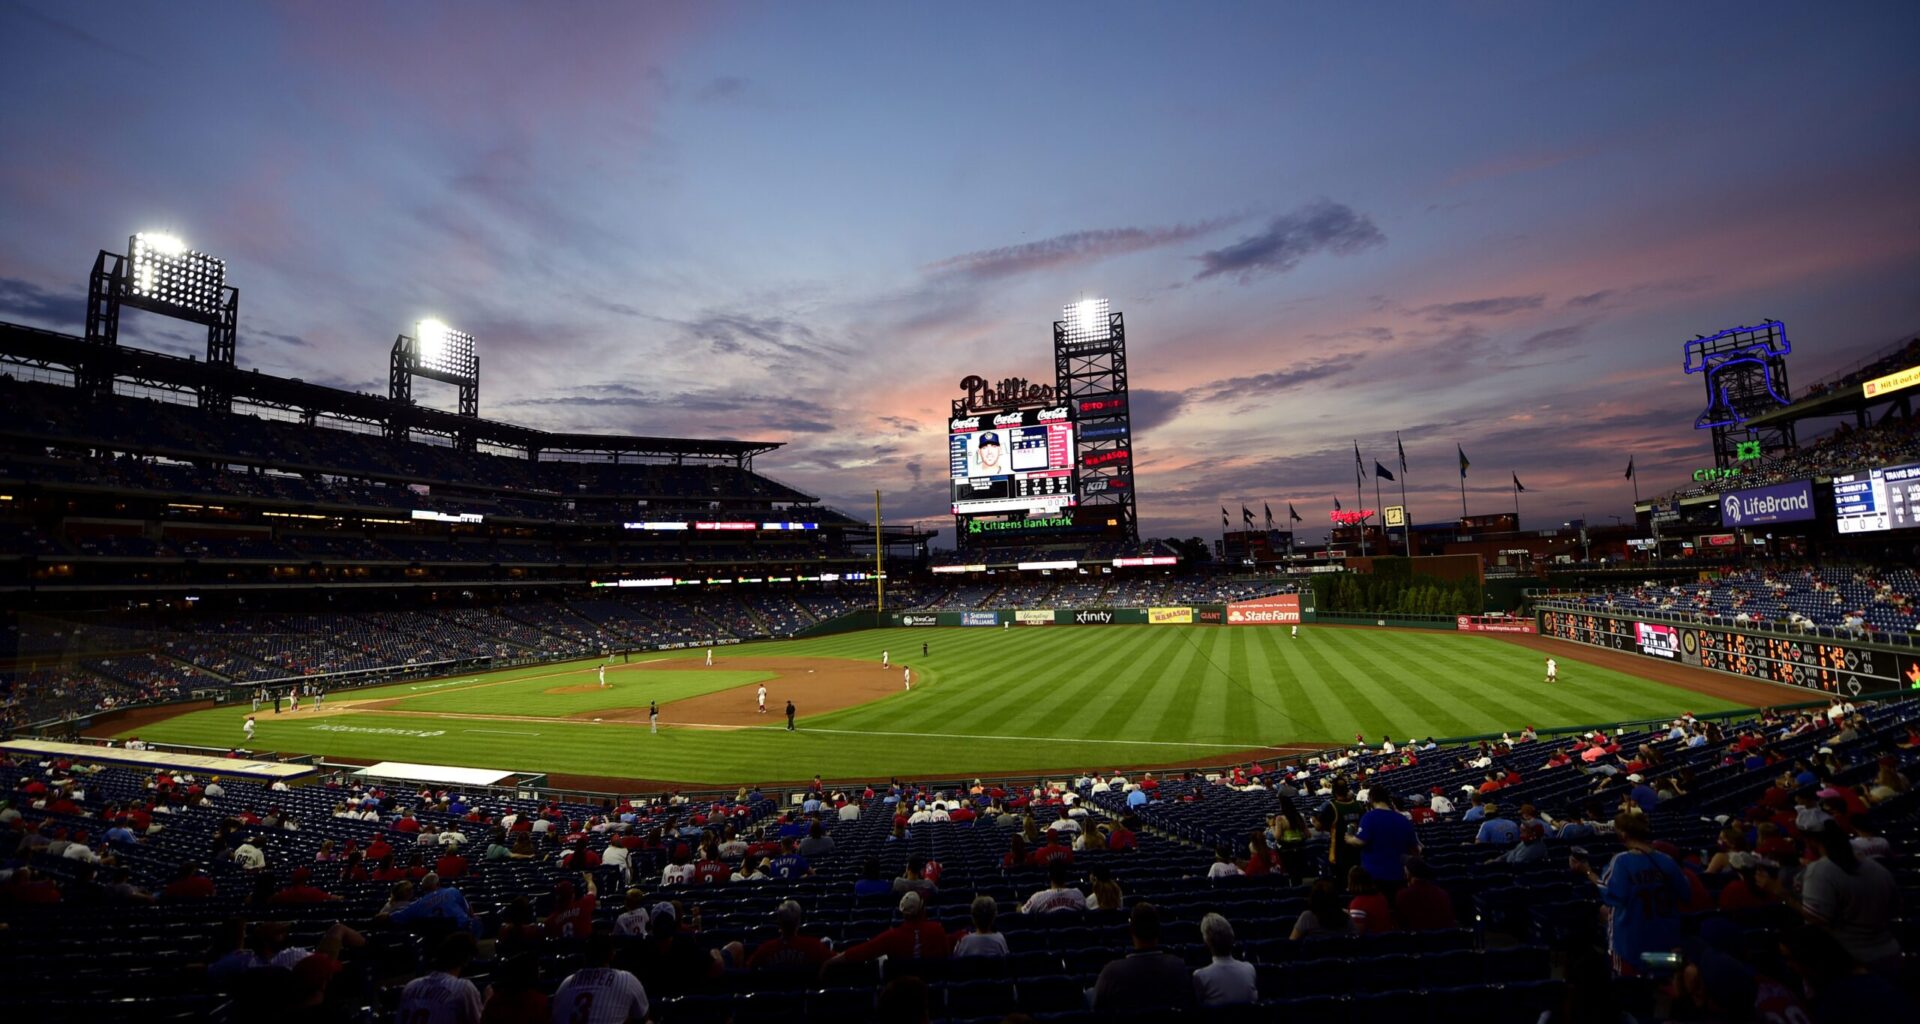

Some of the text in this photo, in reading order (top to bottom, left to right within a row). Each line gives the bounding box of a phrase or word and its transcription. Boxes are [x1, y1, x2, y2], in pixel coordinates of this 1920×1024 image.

[960, 375, 1054, 411] Phillies
[1744, 490, 1808, 515] LifeBrand
[984, 516, 1072, 531] Citizens Bank Park
[1843, 518, 1883, 531] 0 0 2
[1076, 610, 1112, 624] xfinity
[1200, 612, 1221, 620] GIANT
[1861, 651, 1872, 662] PIT
